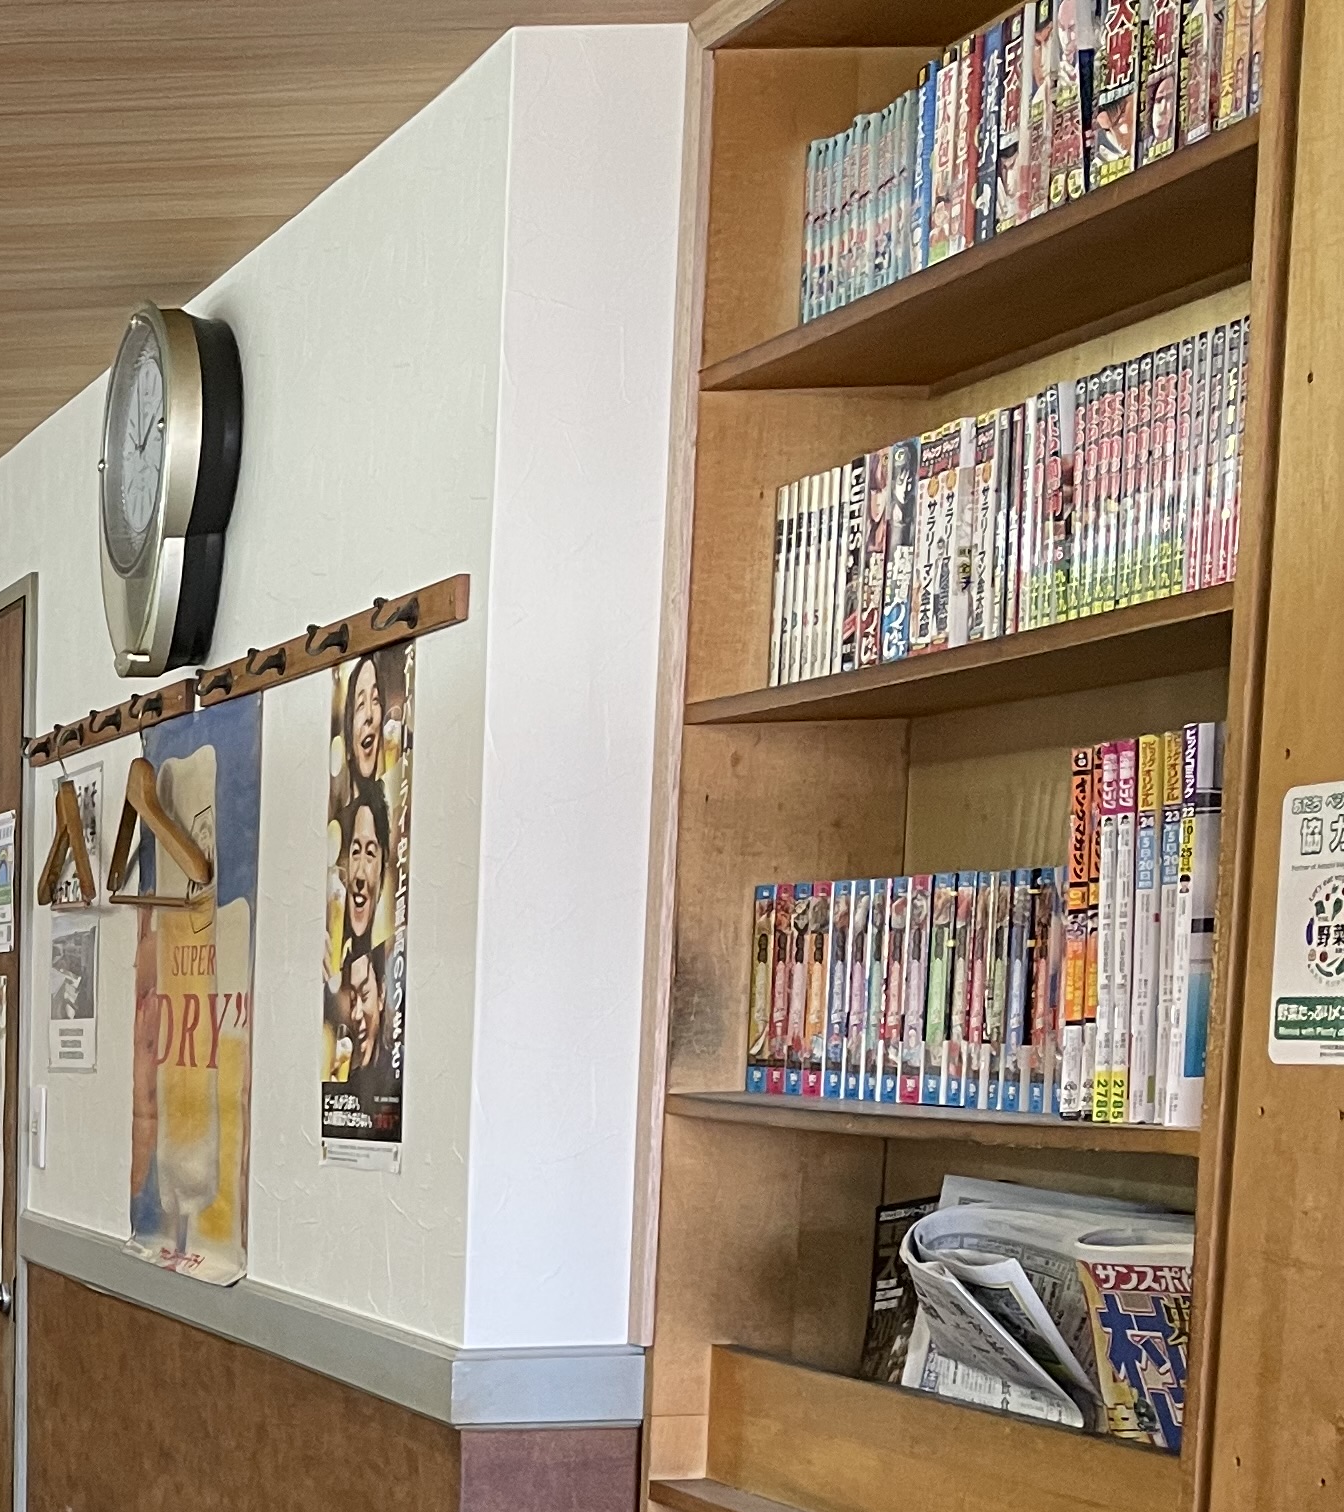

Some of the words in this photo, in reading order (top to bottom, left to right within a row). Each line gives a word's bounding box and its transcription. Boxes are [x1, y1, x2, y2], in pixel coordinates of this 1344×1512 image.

[919, 501, 938, 637] サラリーマン金太郎
[974, 486, 991, 625] サラリーマン金太郎
[171, 944, 216, 977] SUPER
[1095, 1079, 1109, 1120] 2786
[1112, 1079, 1125, 1120] 2785
